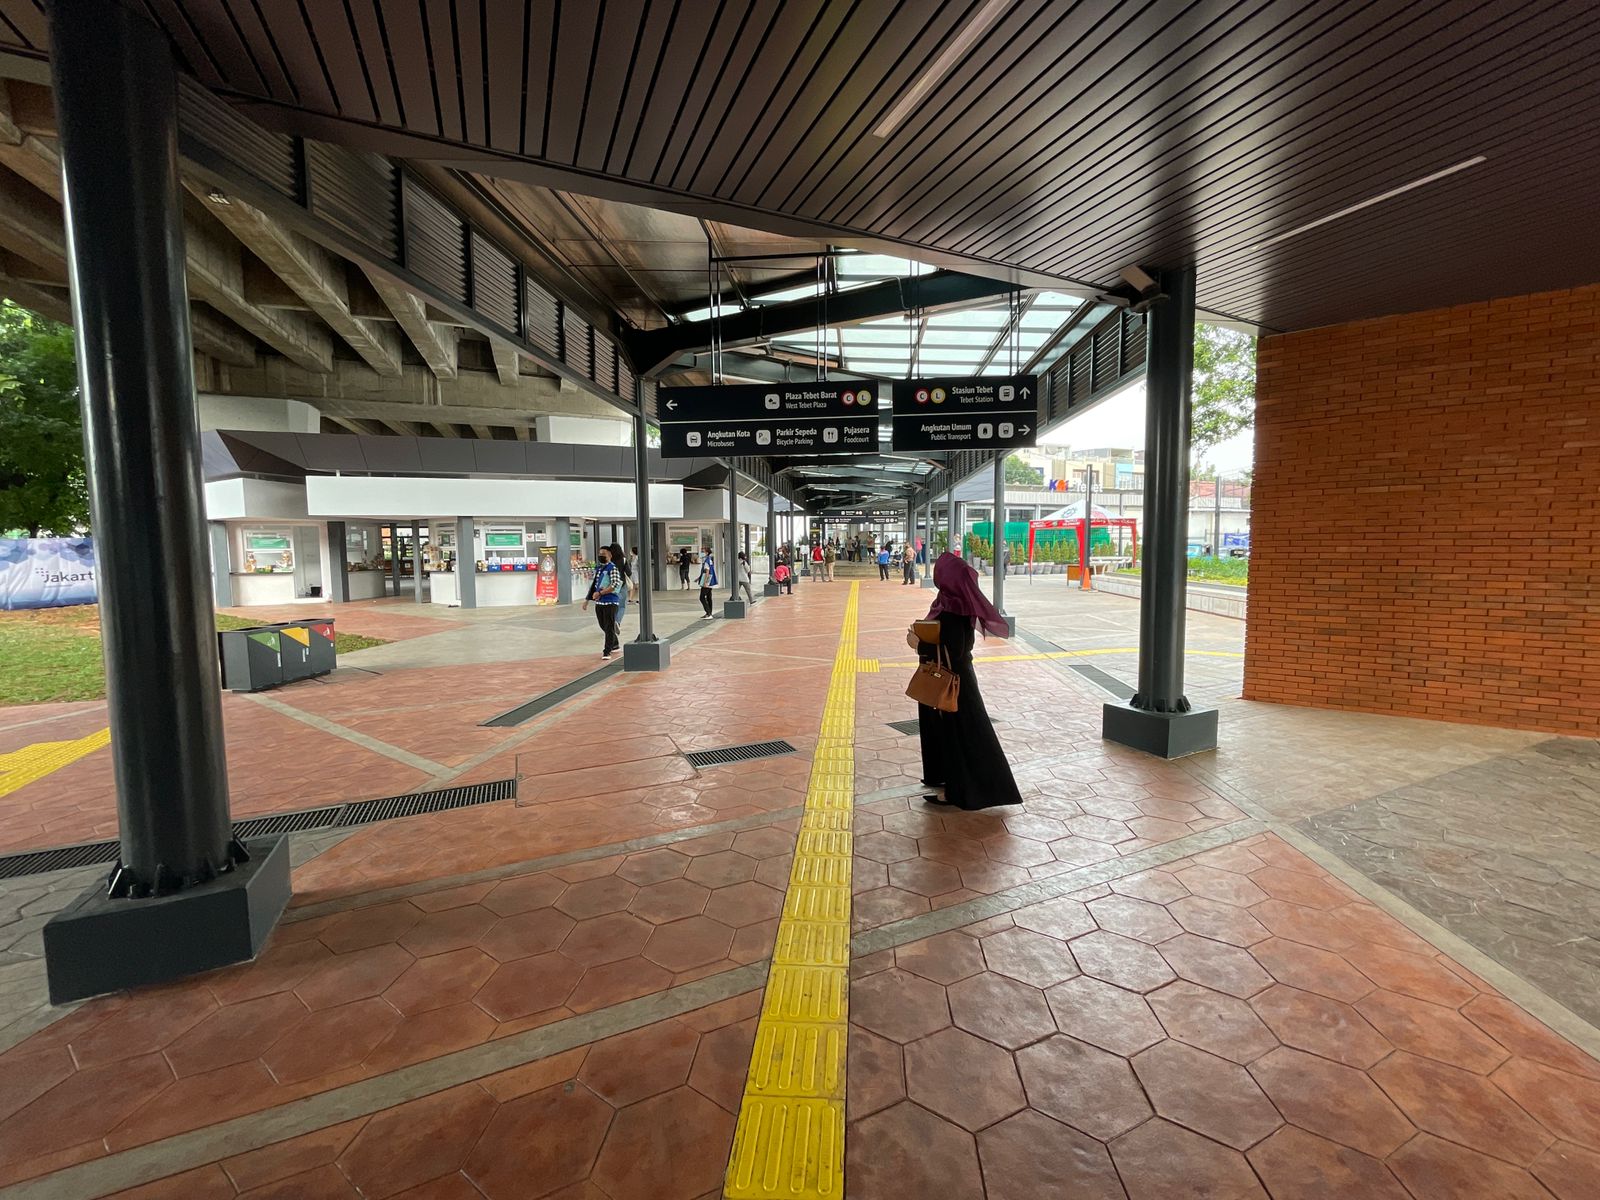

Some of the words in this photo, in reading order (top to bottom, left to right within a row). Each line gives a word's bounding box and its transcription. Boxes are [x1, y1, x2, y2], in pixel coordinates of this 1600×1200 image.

[952, 386, 975, 395] Stasiun
[975, 386, 993, 394] Tebet
[785, 392, 802, 400] Plaza
[802, 391, 820, 400] Tebet
[820, 391, 837, 399] Barat
[960, 396, 974, 404] Tebet
[974, 395, 994, 403] Station
[776, 428, 794, 437] Parkir
[795, 427, 817, 437] Sepeda
[843, 426, 870, 435] Pujasera
[921, 424, 951, 434] Angkutan
[951, 423, 972, 431] Umum
[707, 430, 736, 440] Angkutan
[736, 429, 751, 438] Kota
[930, 433, 947, 441] Public
[947, 433, 971, 441] Transport
[776, 438, 794, 446] Bicycle
[794, 437, 813, 446] Parking
[1076, 480, 1103, 493] Teet
[43, 570, 95, 583] jakart
